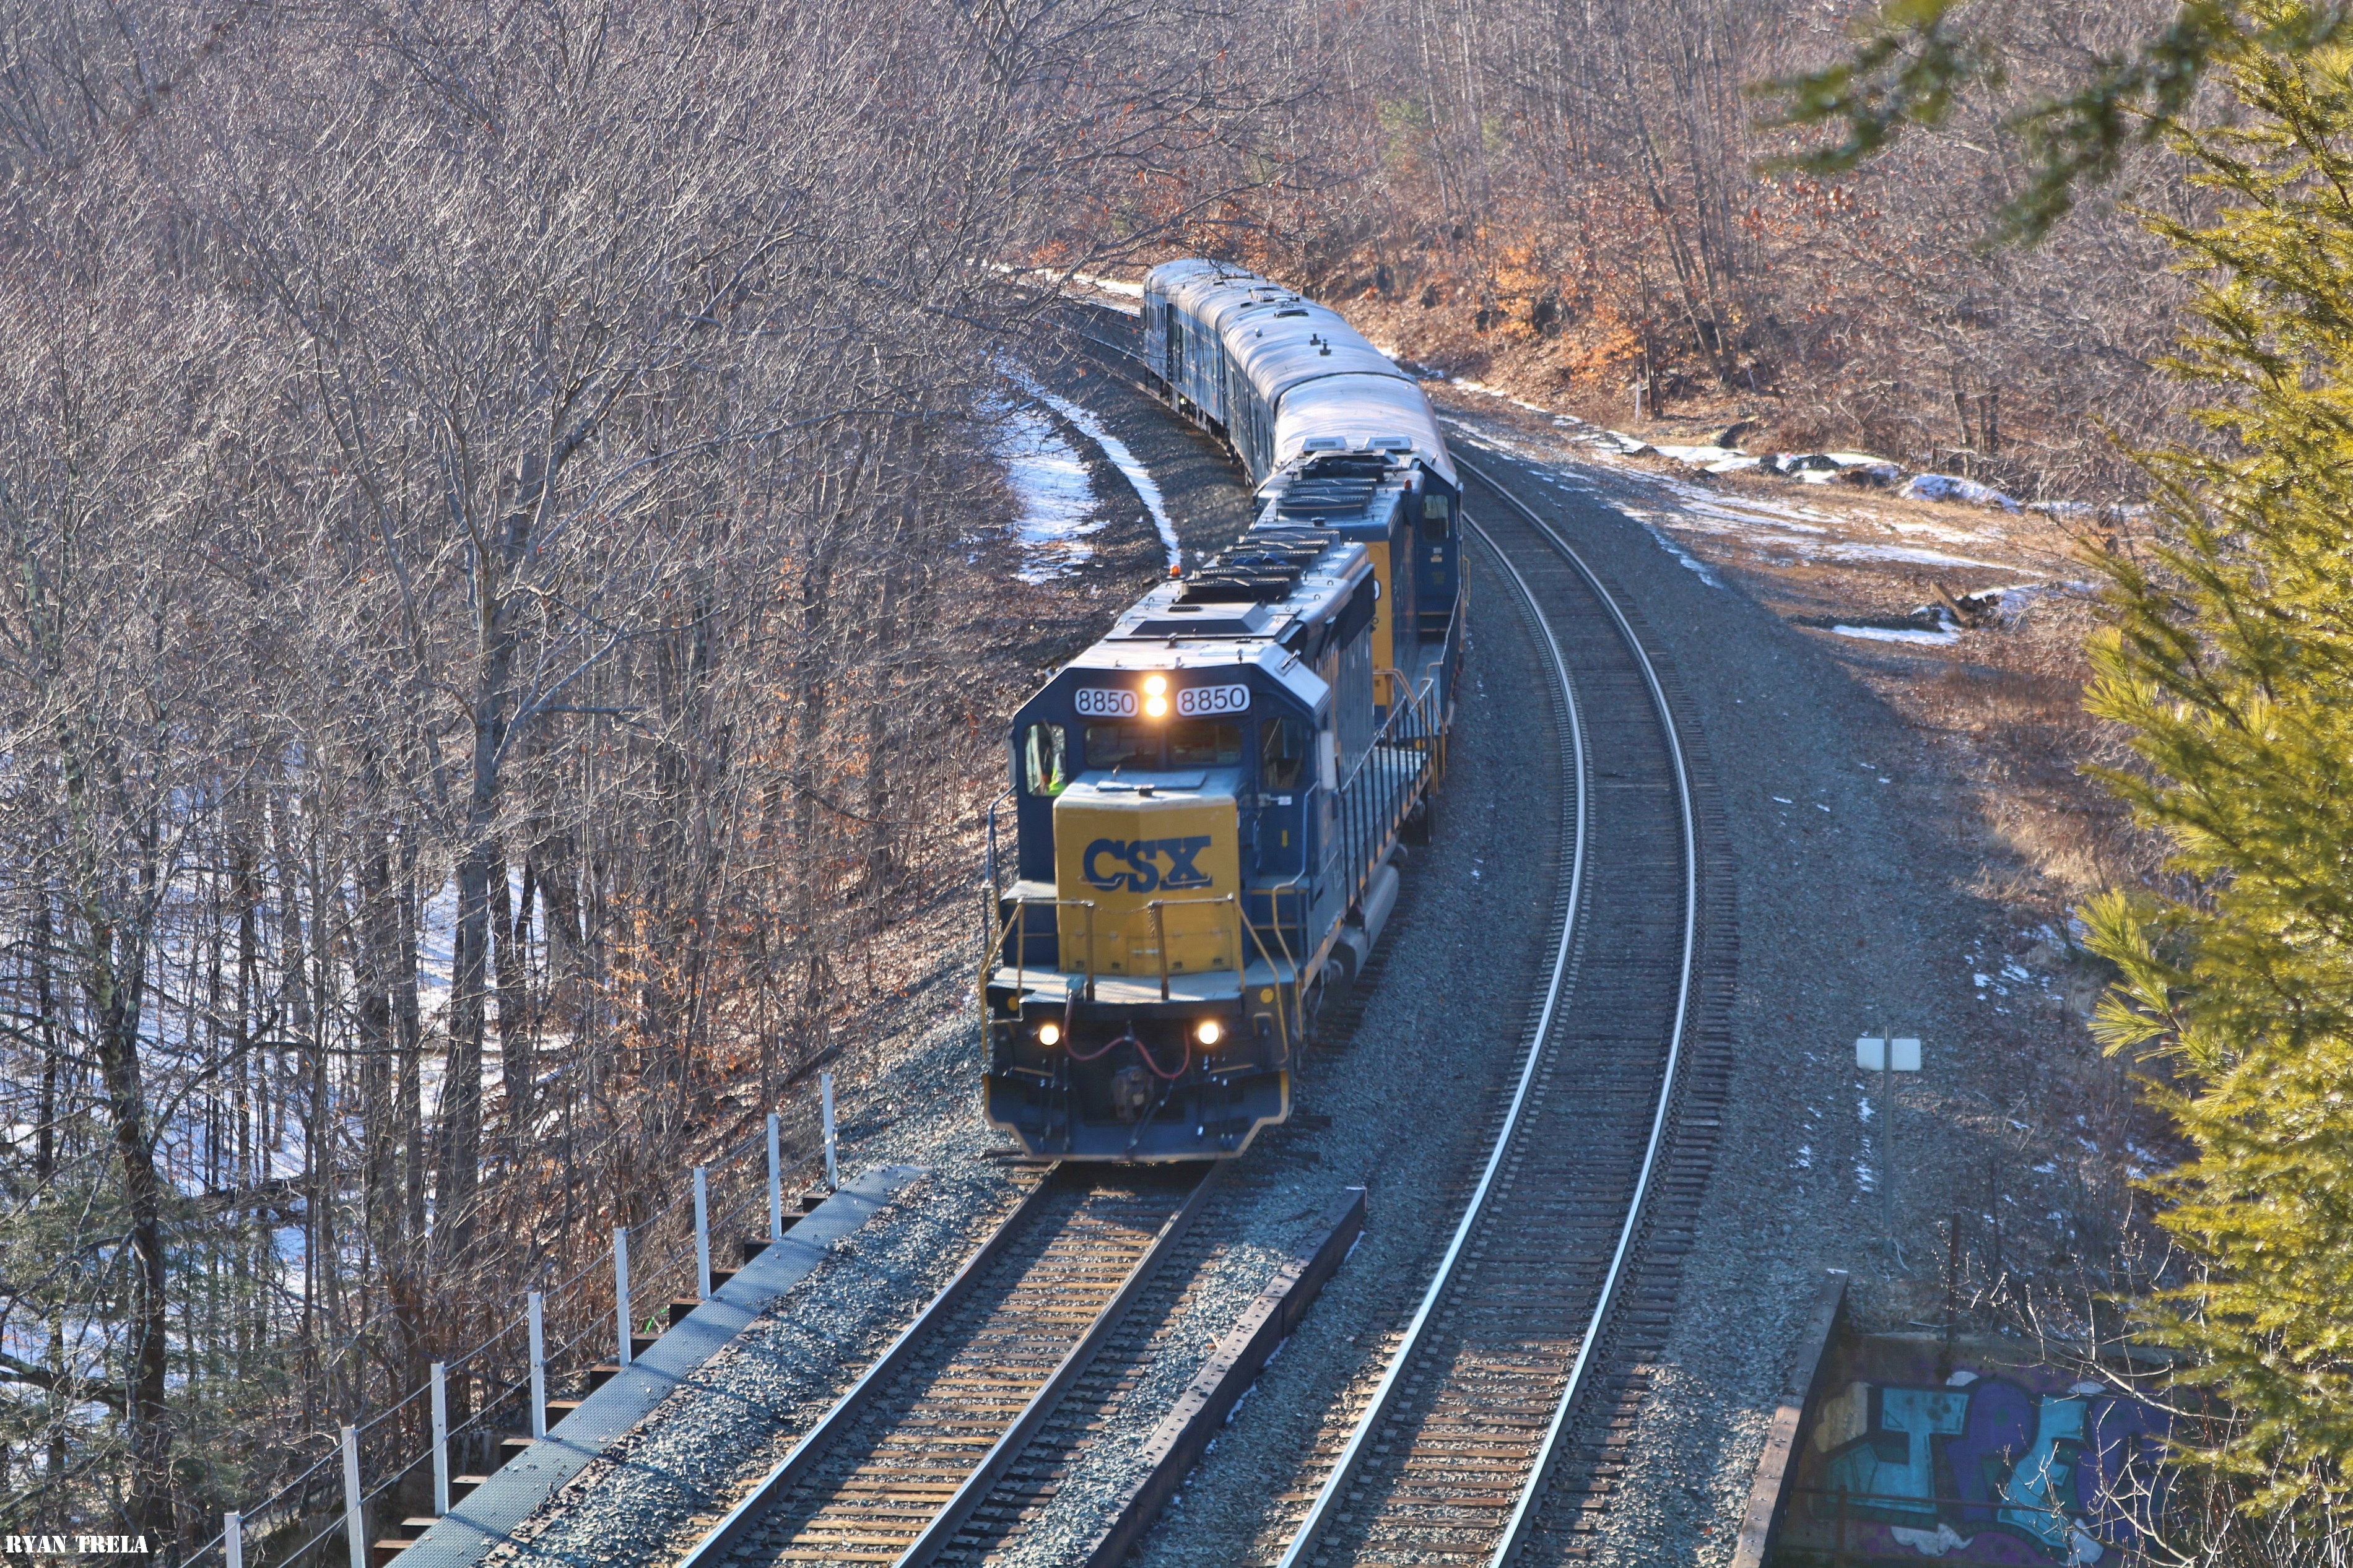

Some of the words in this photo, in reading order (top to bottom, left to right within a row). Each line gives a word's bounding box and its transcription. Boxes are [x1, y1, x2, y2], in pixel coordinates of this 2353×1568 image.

[1078, 690, 1134, 714] 8850
[1181, 687, 1246, 713] 8850
[1083, 835, 1213, 893] CSX
